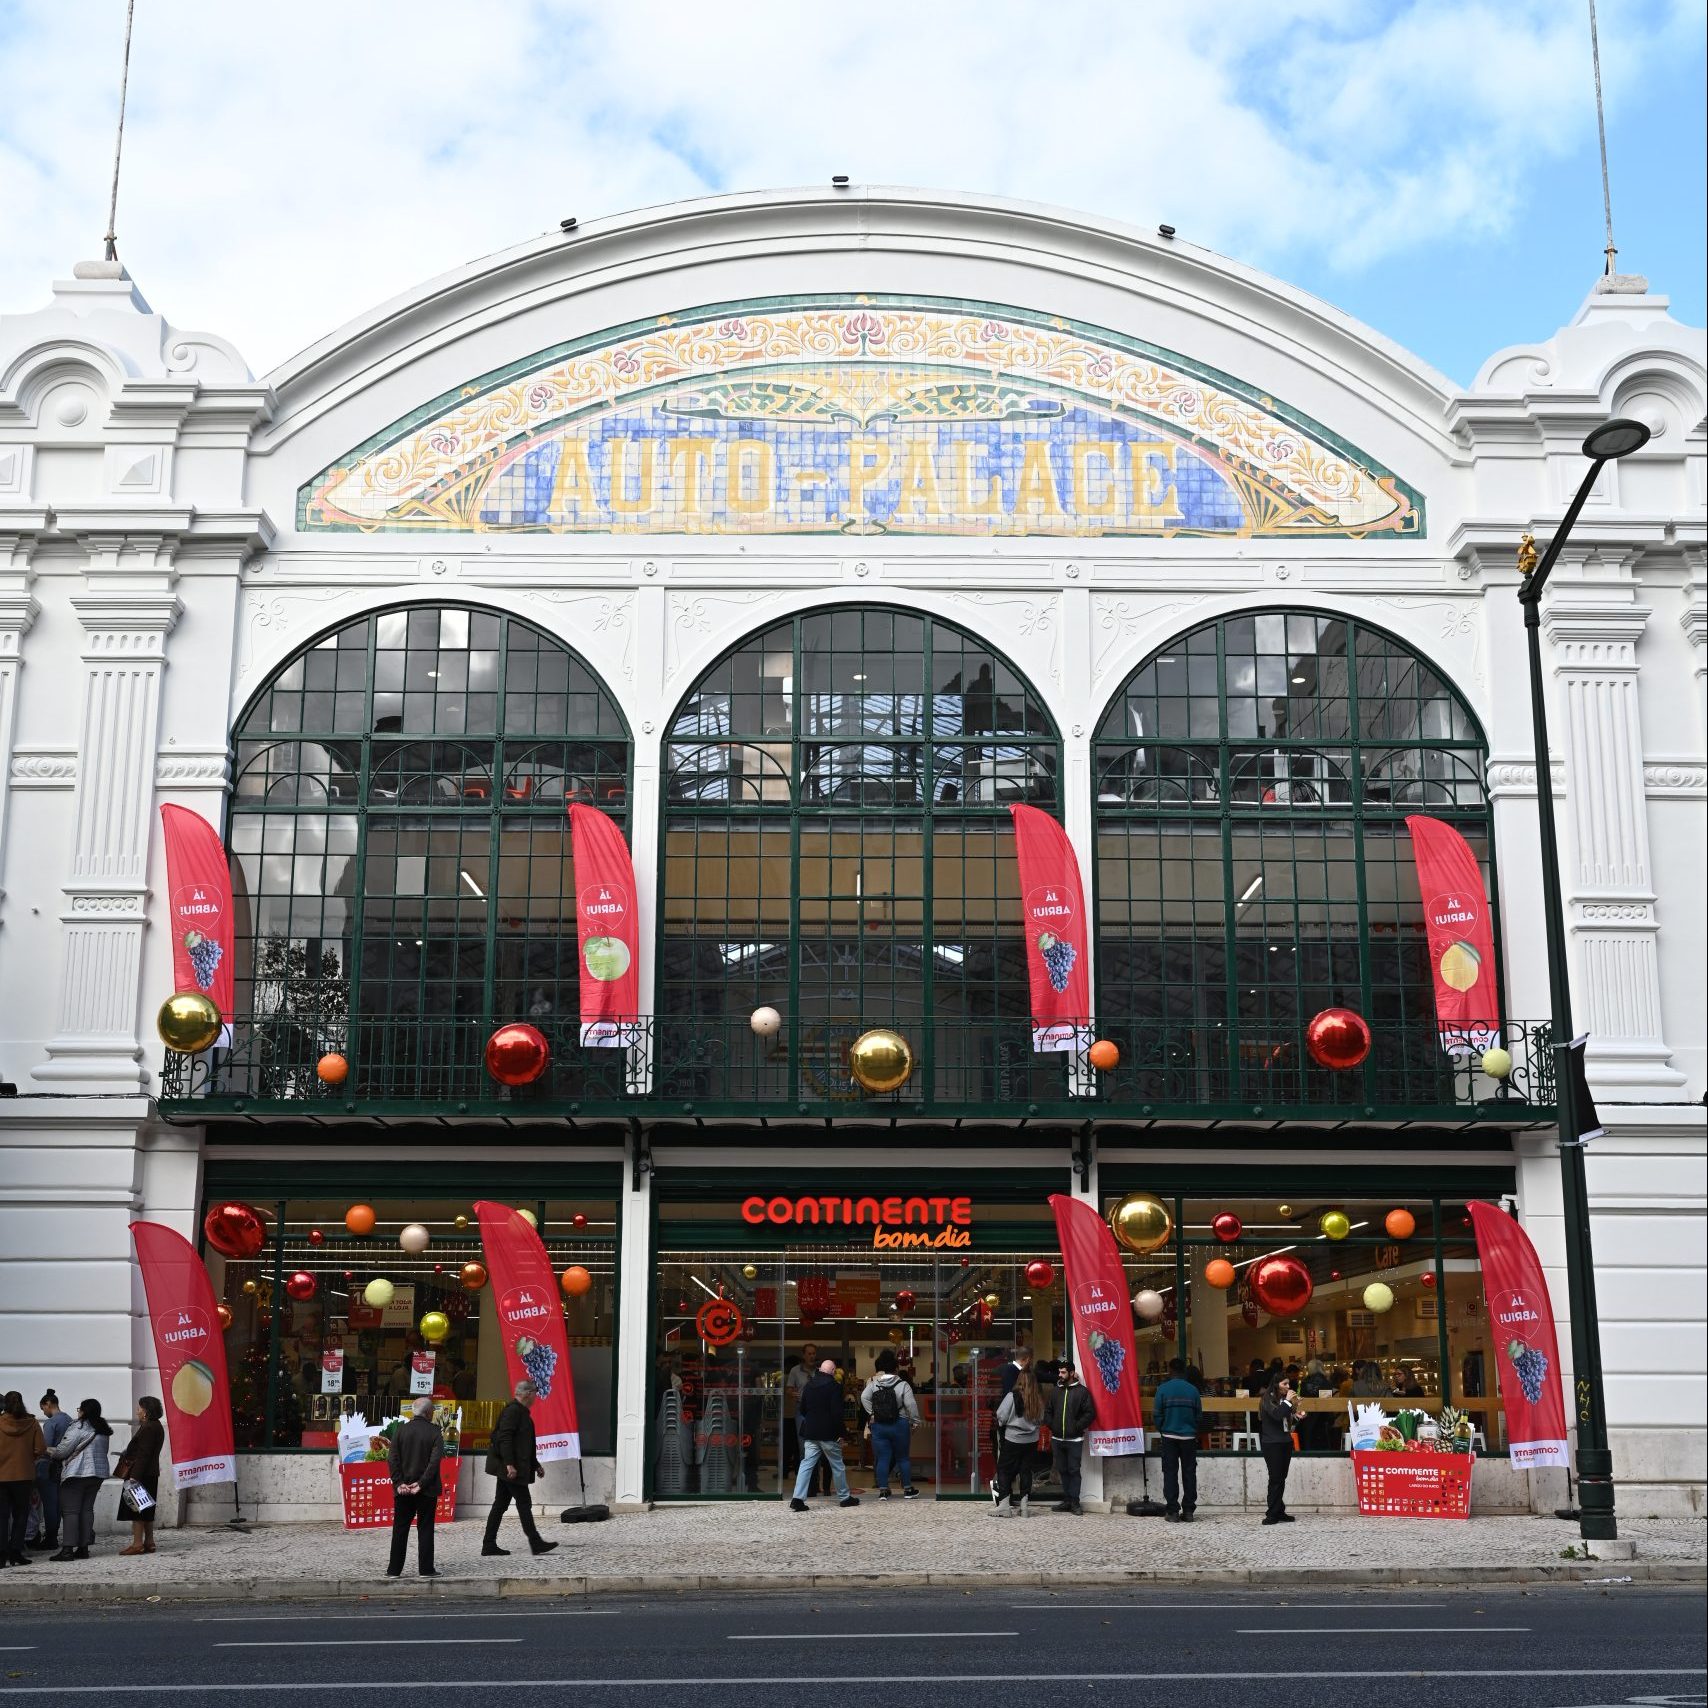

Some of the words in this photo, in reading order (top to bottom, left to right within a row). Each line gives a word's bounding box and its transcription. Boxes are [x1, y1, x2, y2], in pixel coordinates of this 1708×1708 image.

[741, 1196, 972, 1226] CONTINENTE
[873, 1225, 932, 1248] bom
[932, 1225, 971, 1248] dia
[1385, 1467, 1439, 1477] CONTINENTE
